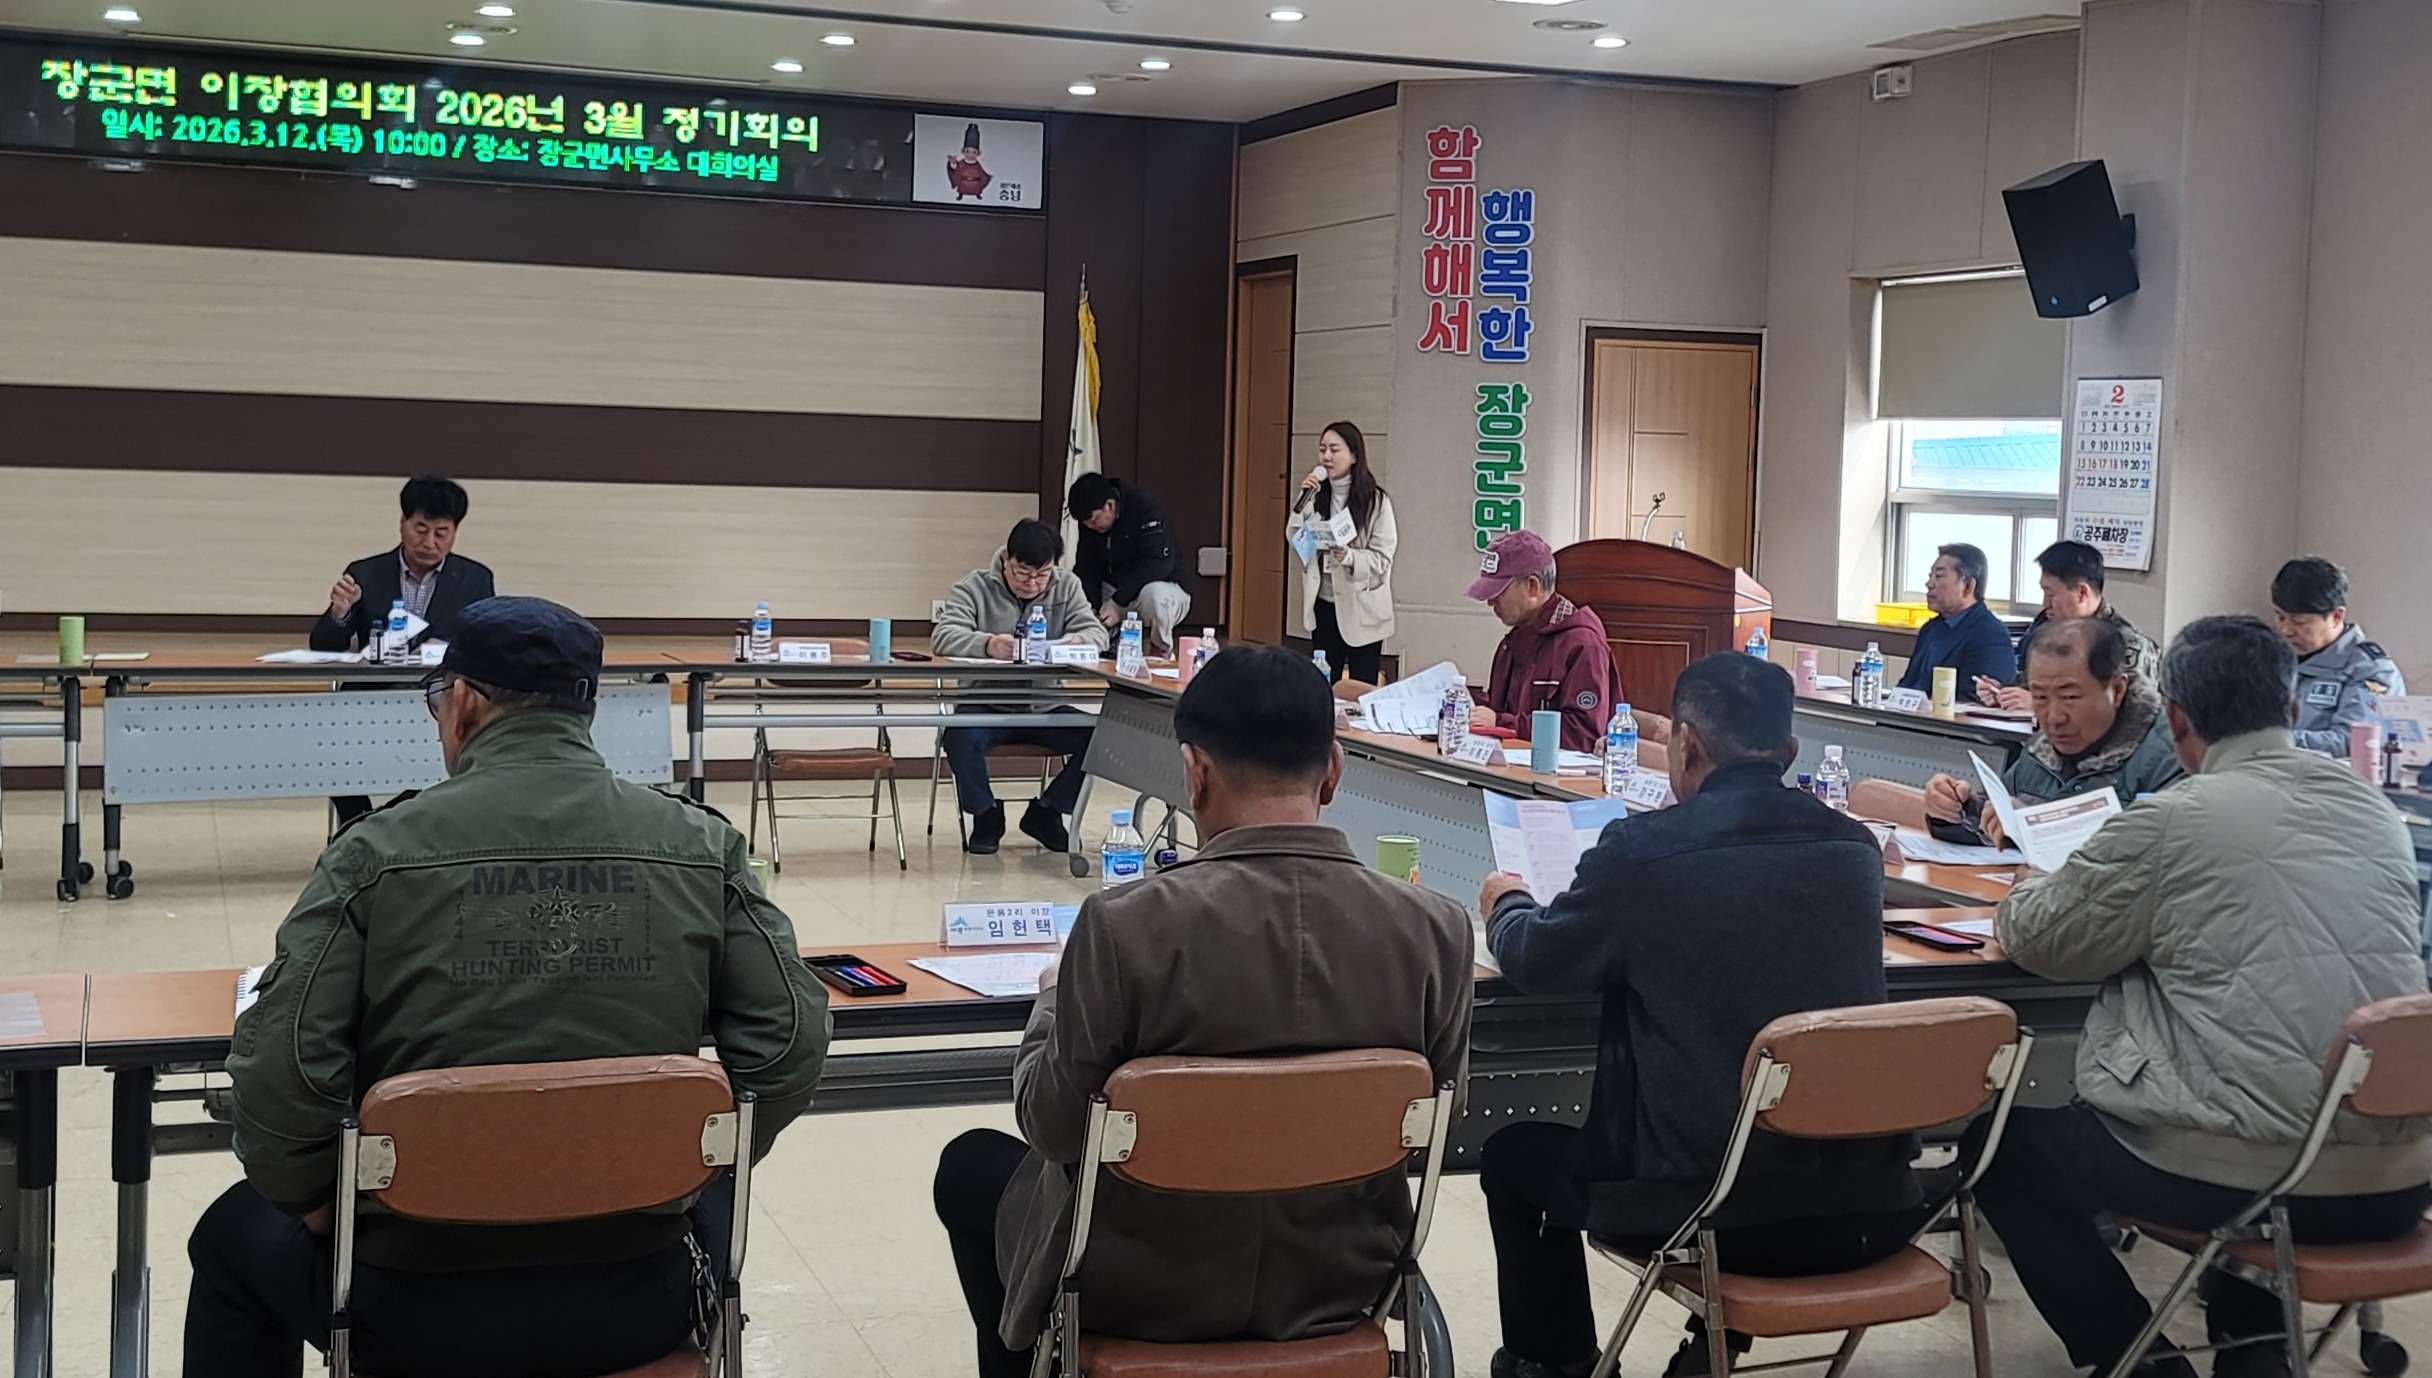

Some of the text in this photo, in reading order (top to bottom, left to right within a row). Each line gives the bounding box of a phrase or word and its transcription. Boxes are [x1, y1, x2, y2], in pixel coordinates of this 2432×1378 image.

[41, 59, 819, 152] 장군면 이장협의회 2026년 3월 정기회의
[101, 108, 163, 140] 일시:
[373, 128, 446, 157] 10:00
[451, 134, 466, 159] /
[473, 134, 529, 162] 장소:
[537, 138, 680, 173] 장군면사무소
[1419, 126, 1481, 354] 함께해서
[1473, 190, 1534, 552] 행복한 장군면
[2110, 384, 2125, 404] 2
[2100, 441, 2108, 451] 10
[2111, 441, 2118, 451] 11
[2122, 441, 2130, 452] 12
[2132, 441, 2140, 452] 13
[2078, 458, 2086, 468] 15
[2089, 459, 2096, 469] 16
[2099, 459, 2107, 469] 17
[2120, 460, 2128, 470] 19
[2131, 460, 2140, 470] 20
[2142, 460, 2150, 470] 21
[2076, 476, 2085, 486] 22
[2087, 477, 2096, 487] 23
[2098, 477, 2106, 487] 24
[2109, 477, 2117, 487] 25
[2119, 478, 2128, 488] 26
[2130, 478, 2139, 488] 27
[2084, 526, 2129, 543] 공주폐차장
[472, 865, 634, 895] MARINE
[452, 956, 656, 978] HUNTING PERMIT
